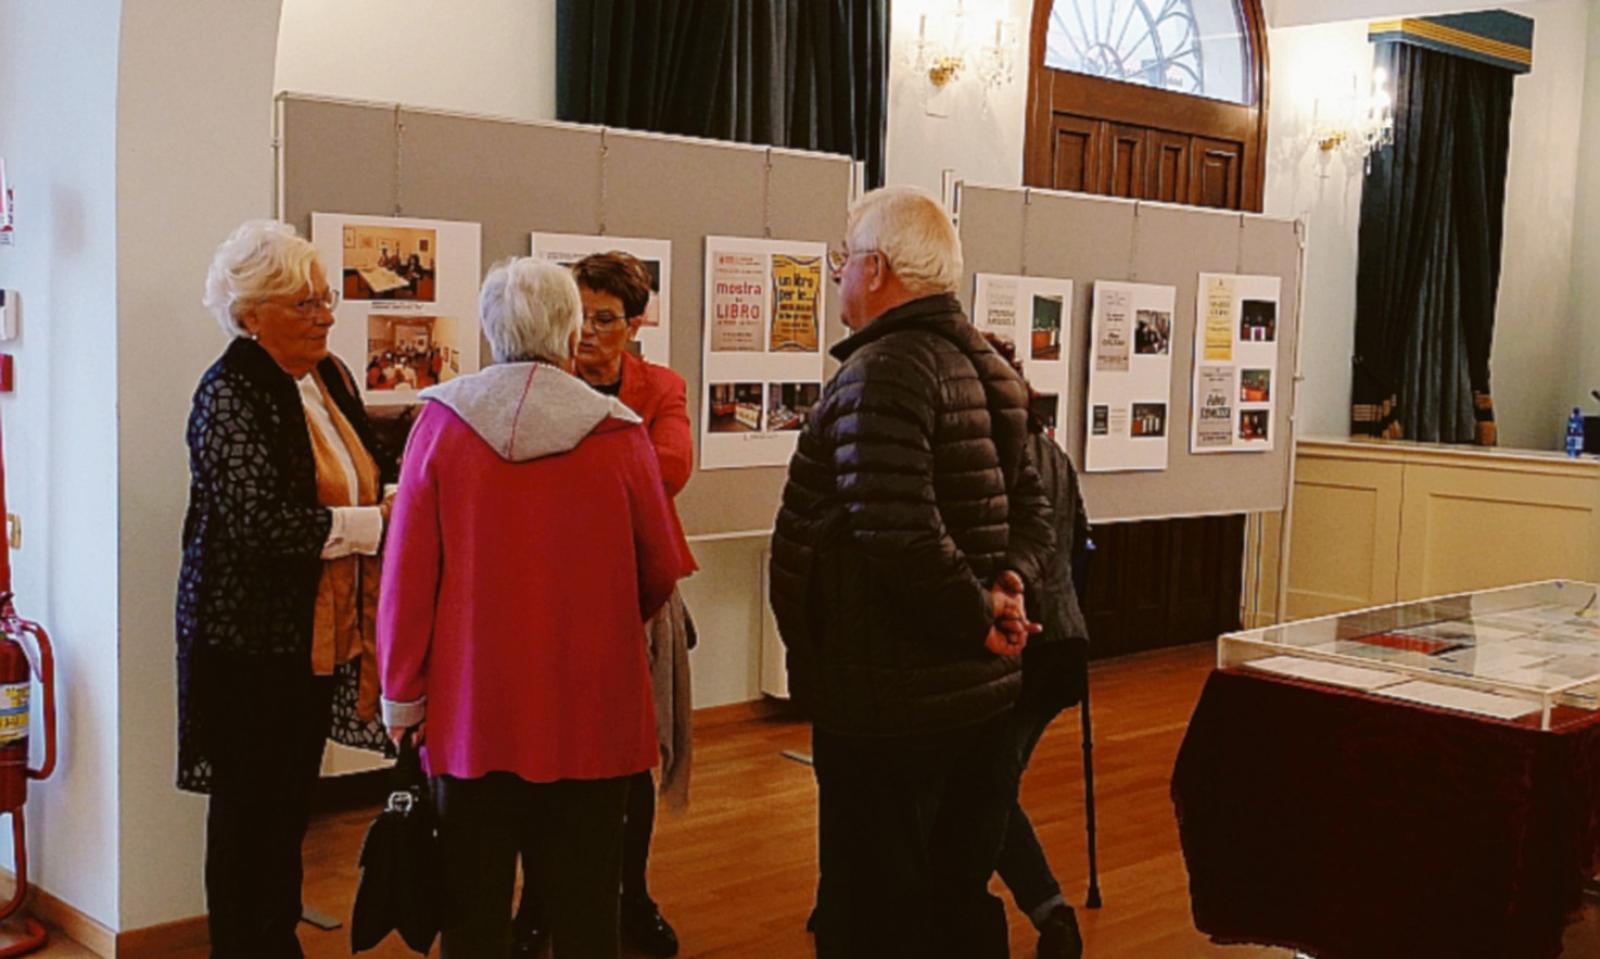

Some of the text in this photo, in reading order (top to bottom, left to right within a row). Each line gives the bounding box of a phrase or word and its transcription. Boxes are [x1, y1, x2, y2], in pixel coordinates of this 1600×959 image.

[717, 281, 762, 295] mostra
[778, 276, 792, 287] un
[716, 303, 760, 320] LIBRO
